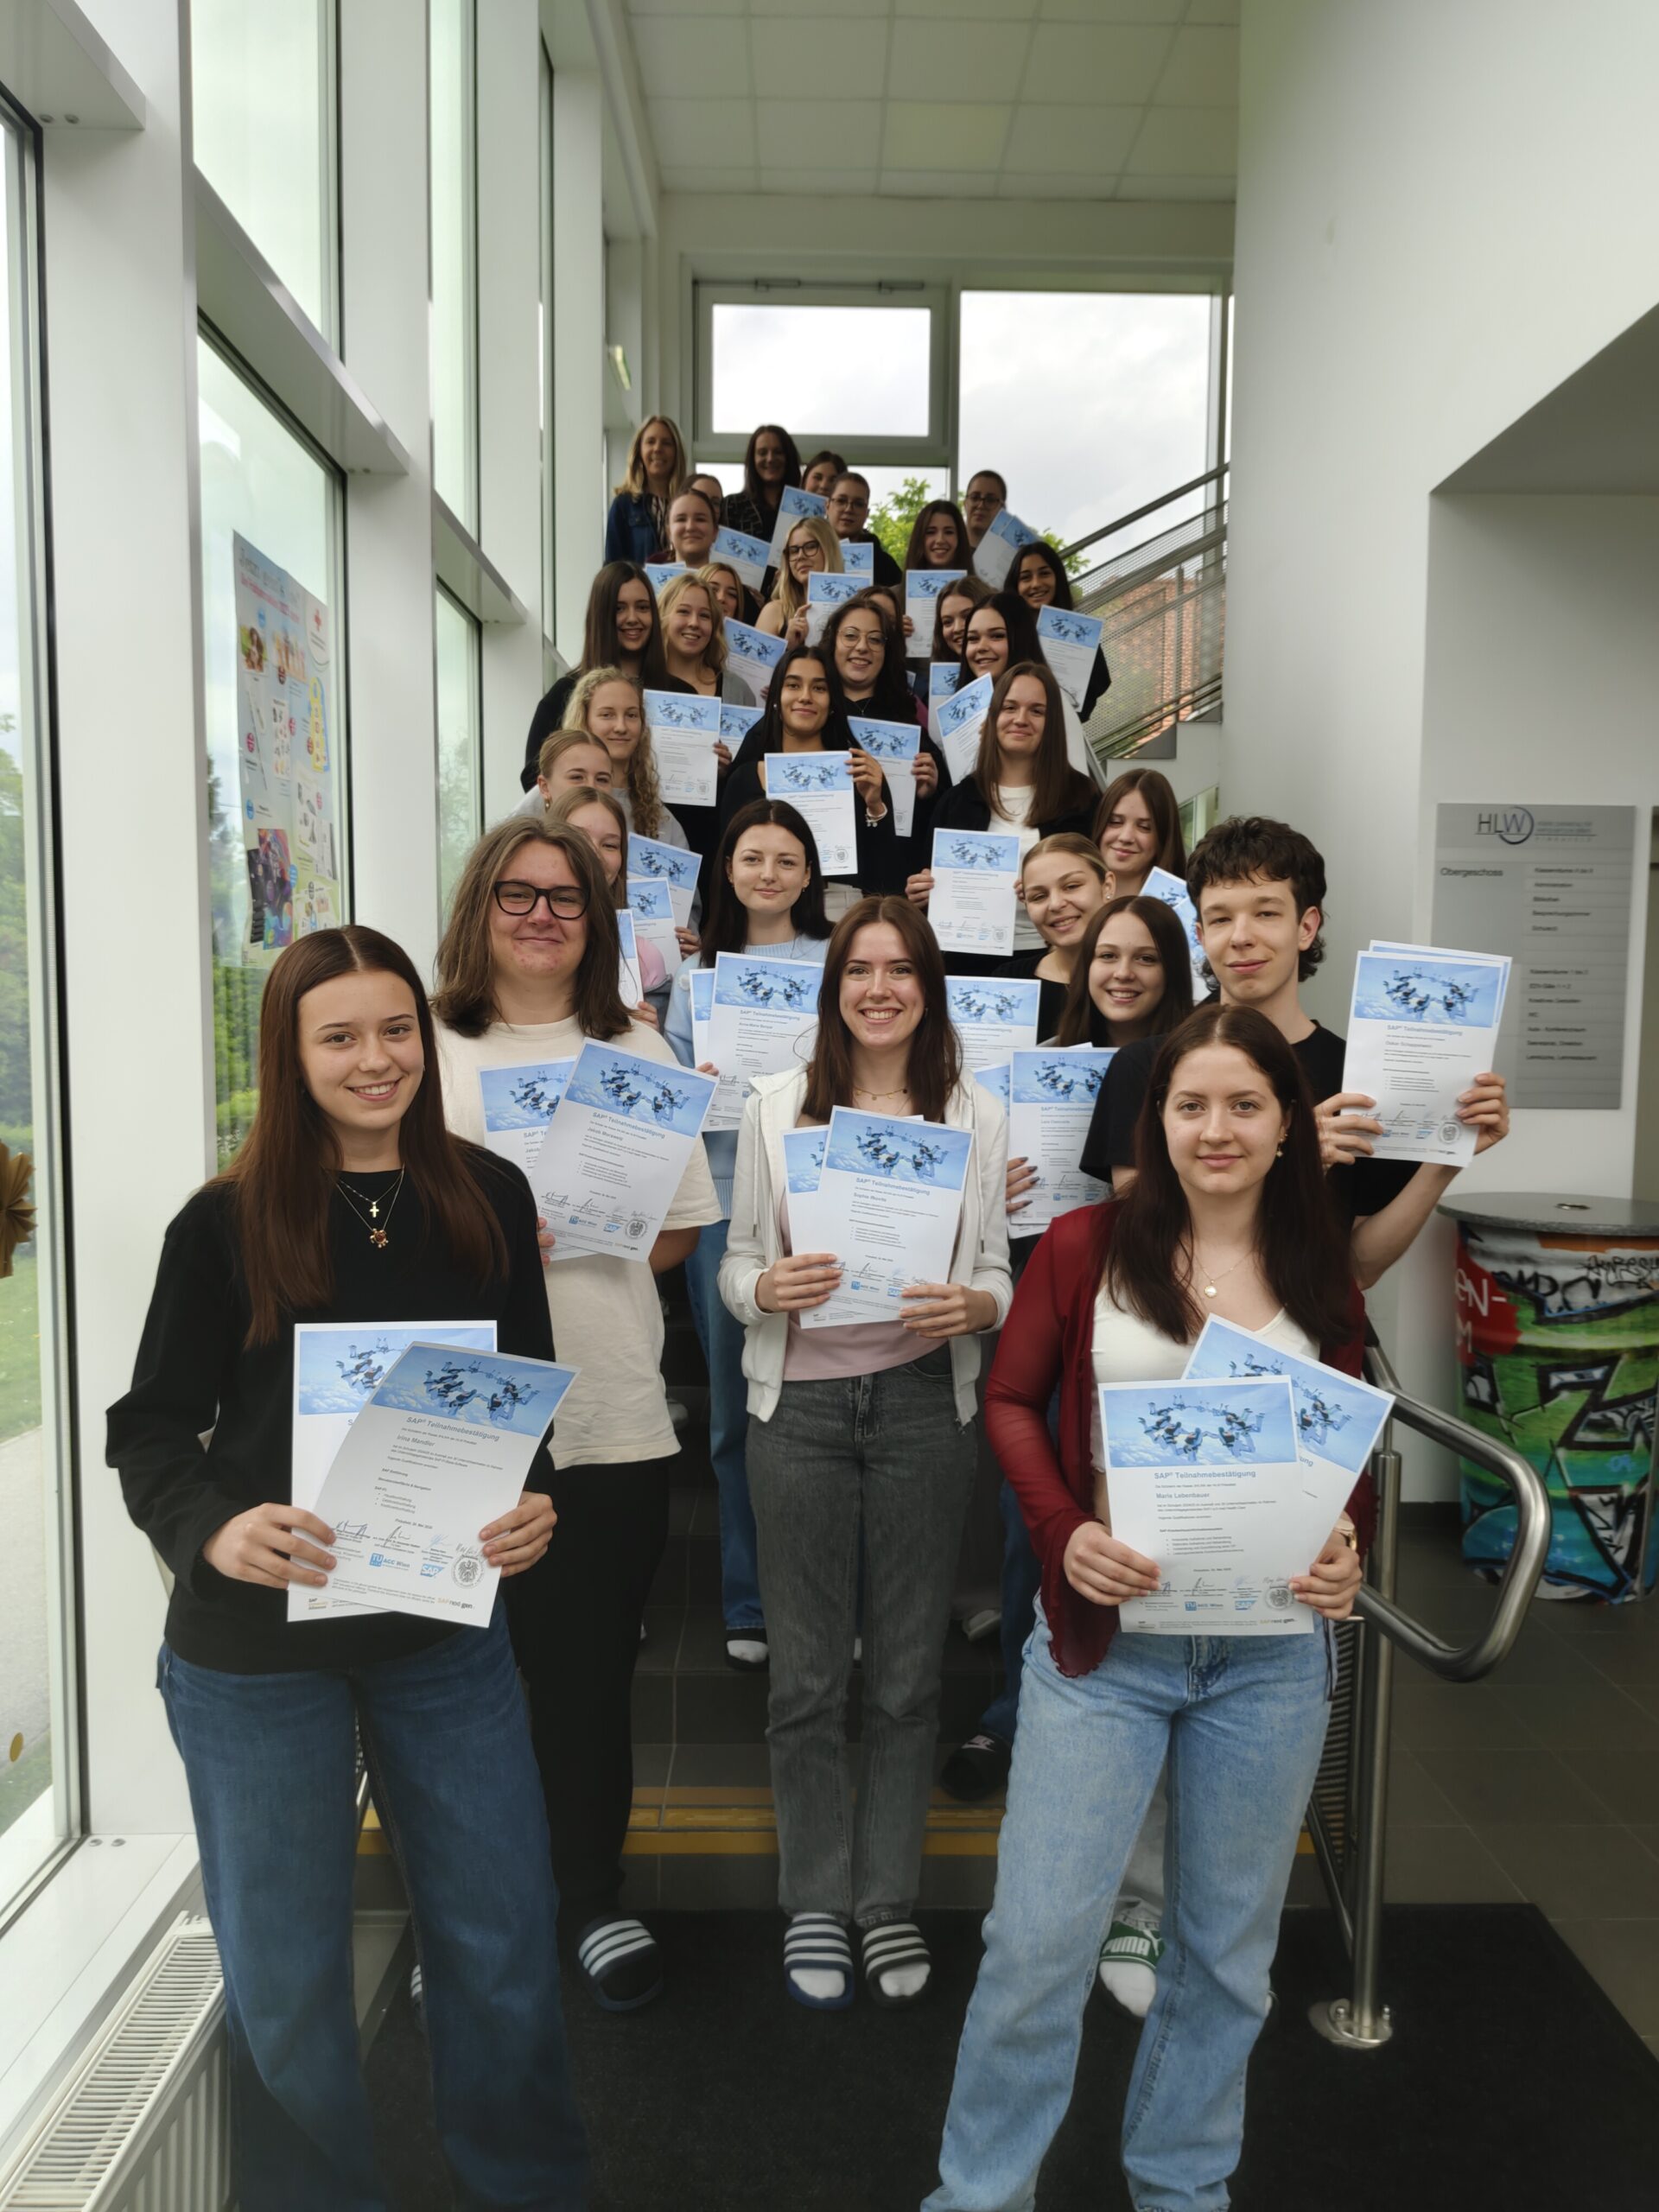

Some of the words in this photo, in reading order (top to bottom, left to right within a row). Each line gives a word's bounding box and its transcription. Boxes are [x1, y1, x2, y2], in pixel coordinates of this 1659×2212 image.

[1478, 813, 1526, 834] HLW
[1440, 868, 1503, 878] Obergeschoss
[427, 1420, 499, 1442] Teilnahmebestätigung
[1175, 1470, 1255, 1479] Teilnahmebestätigung
